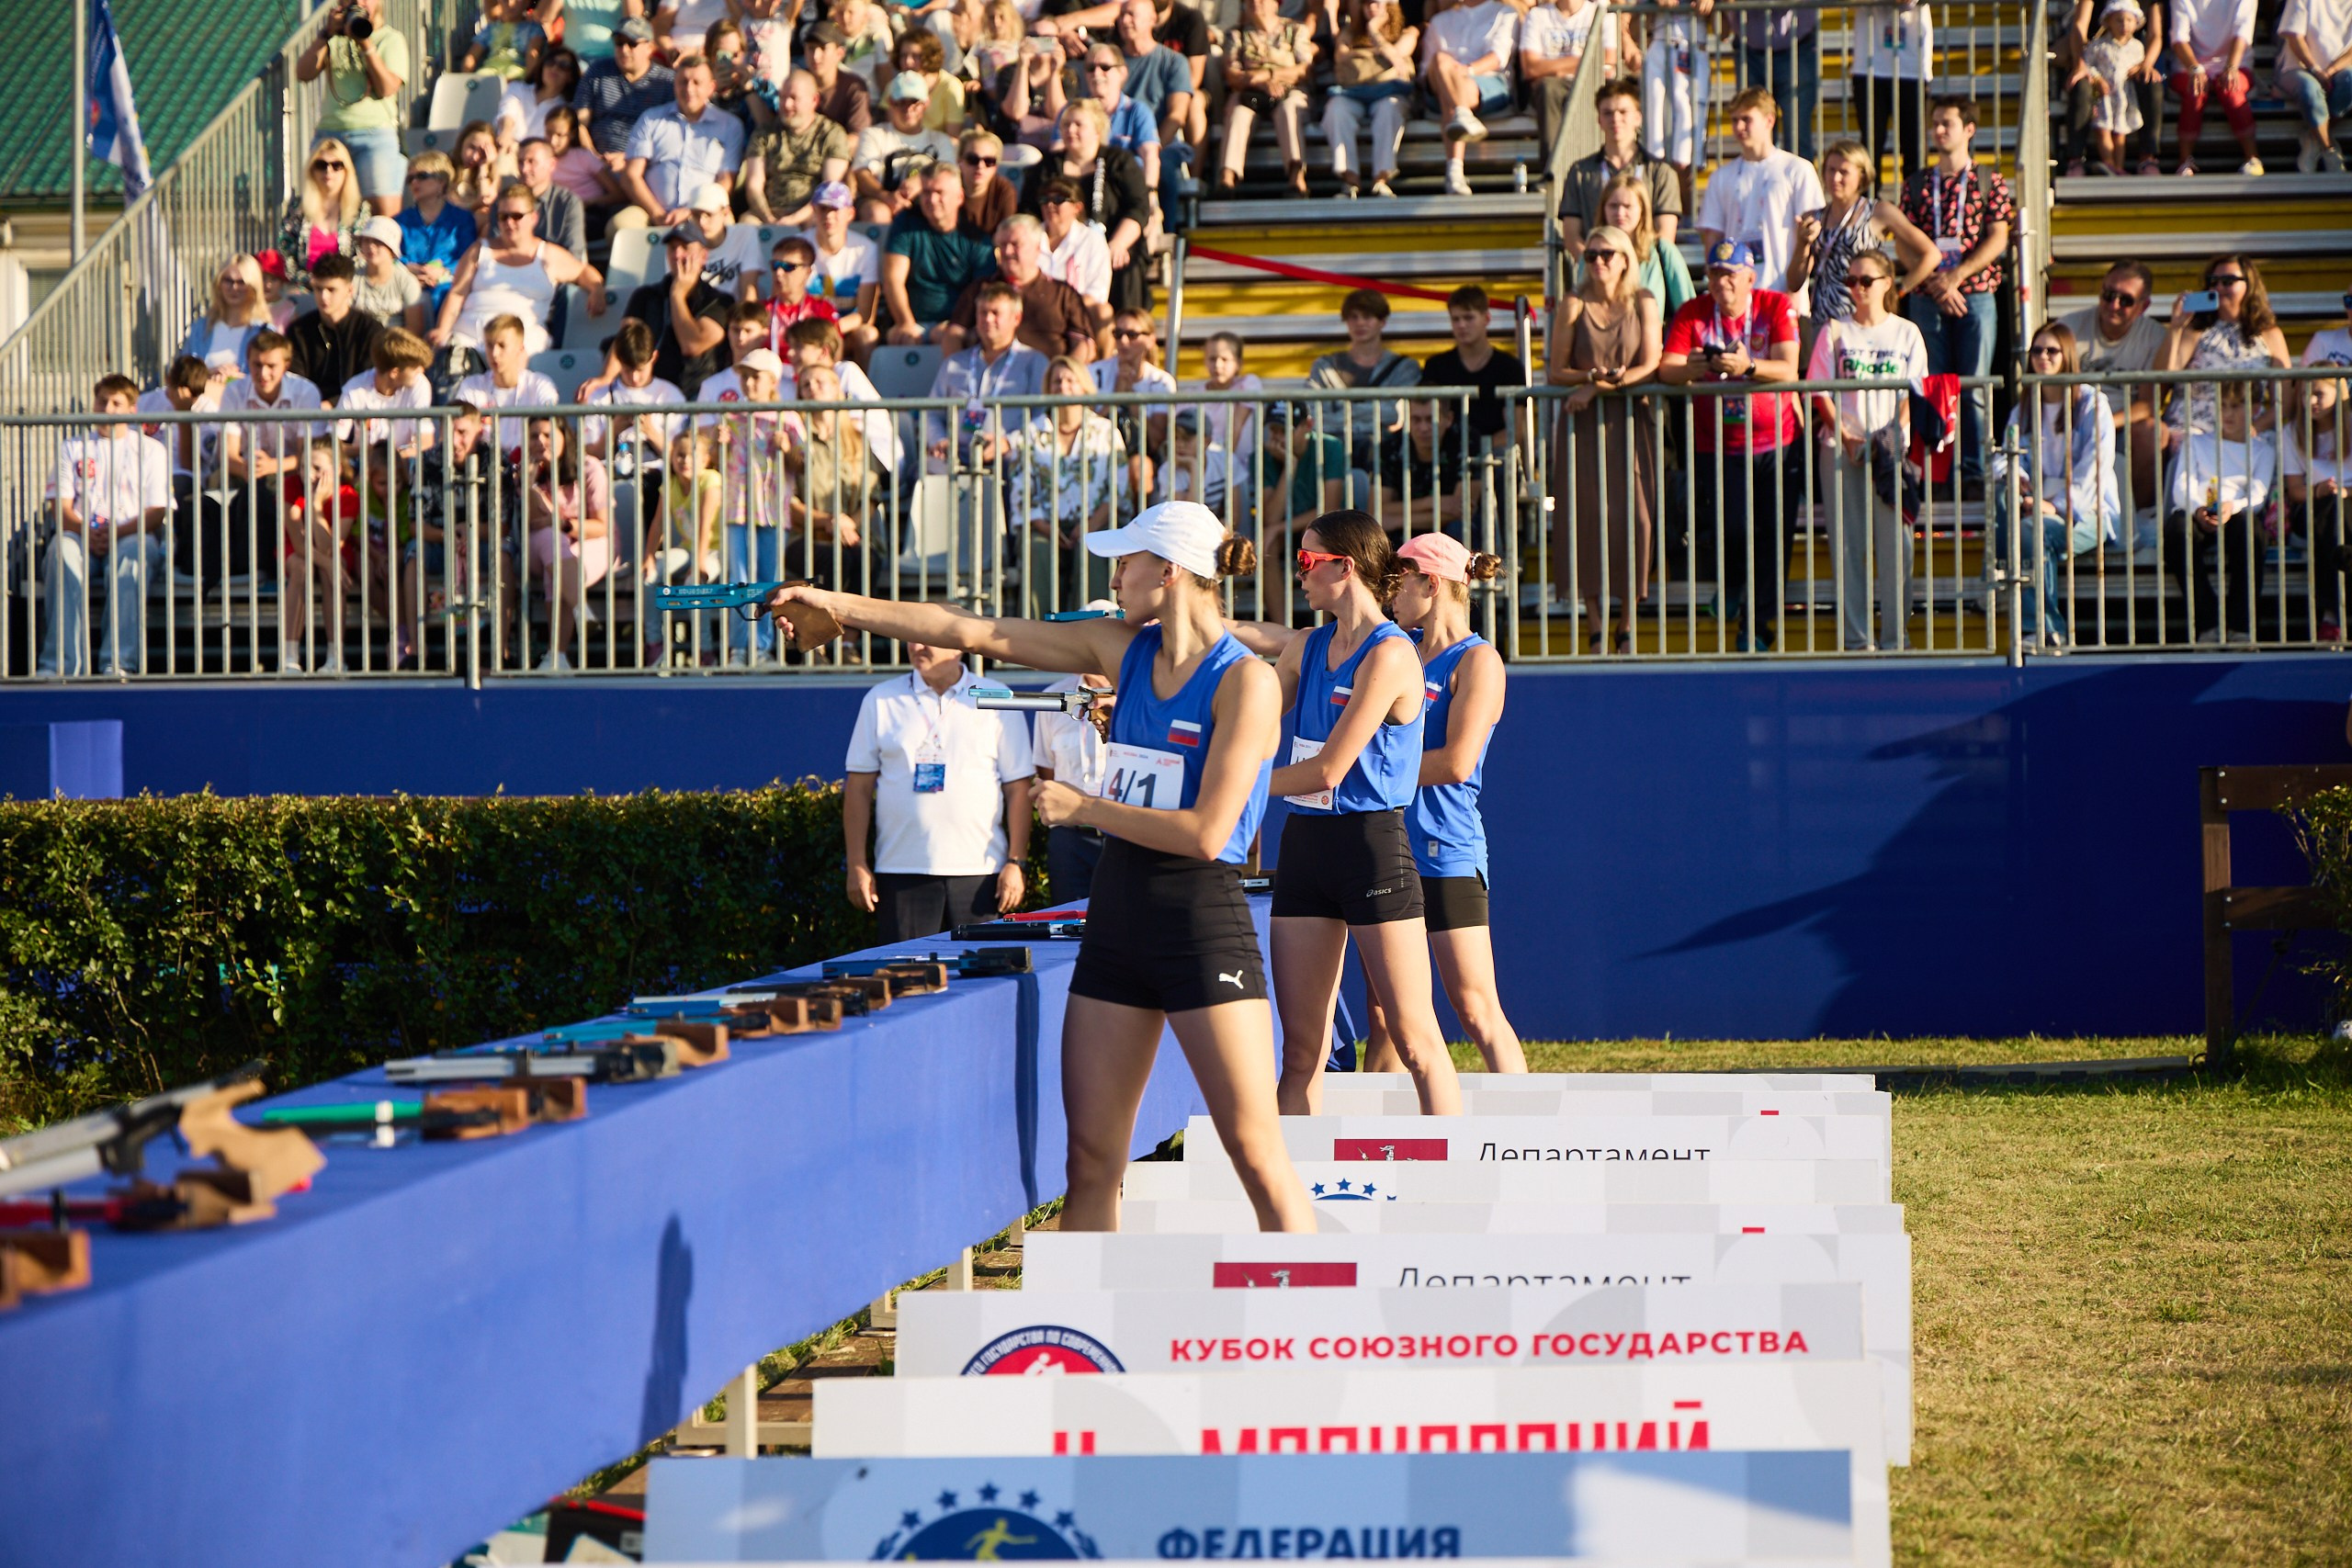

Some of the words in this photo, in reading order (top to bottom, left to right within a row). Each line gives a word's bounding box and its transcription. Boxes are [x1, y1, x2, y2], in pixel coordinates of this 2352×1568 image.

[1843, 358, 1899, 374] Rhode
[1108, 768, 1157, 807] 4/1
[1170, 1337, 1295, 1361] КУБОК
[1308, 1335, 1518, 1359] СОЮЗНОГО
[1532, 1331, 1809, 1360] ГОСУДАРСТВА
[1157, 1526, 1461, 1559] ФЕДЕРАЦИЯ
